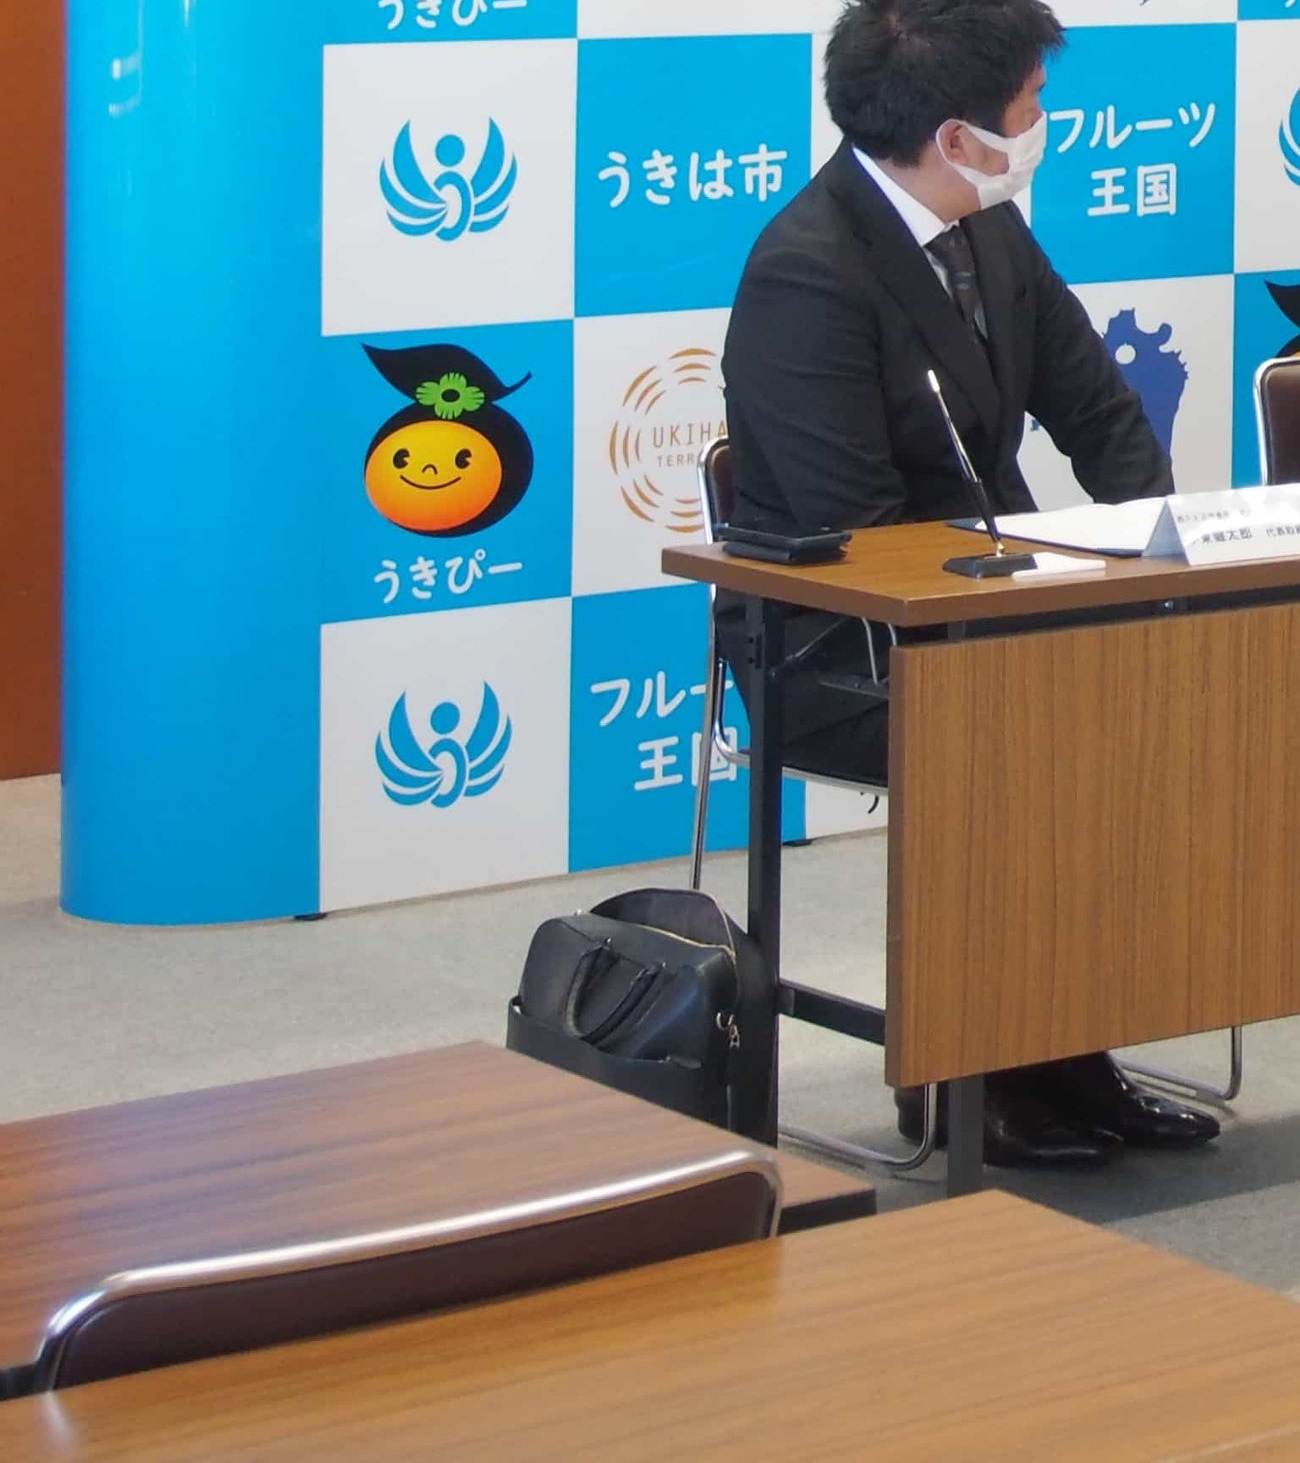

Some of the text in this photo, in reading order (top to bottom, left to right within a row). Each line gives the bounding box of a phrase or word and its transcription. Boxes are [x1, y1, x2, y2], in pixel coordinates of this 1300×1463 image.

[1050, 104, 1215, 152] フルーツ
[599, 145, 786, 206] うきは市
[1088, 164, 1176, 215] 王国
[652, 420, 727, 448] UKIHA
[374, 549, 523, 604] うきぴー
[591, 670, 735, 728] フルー
